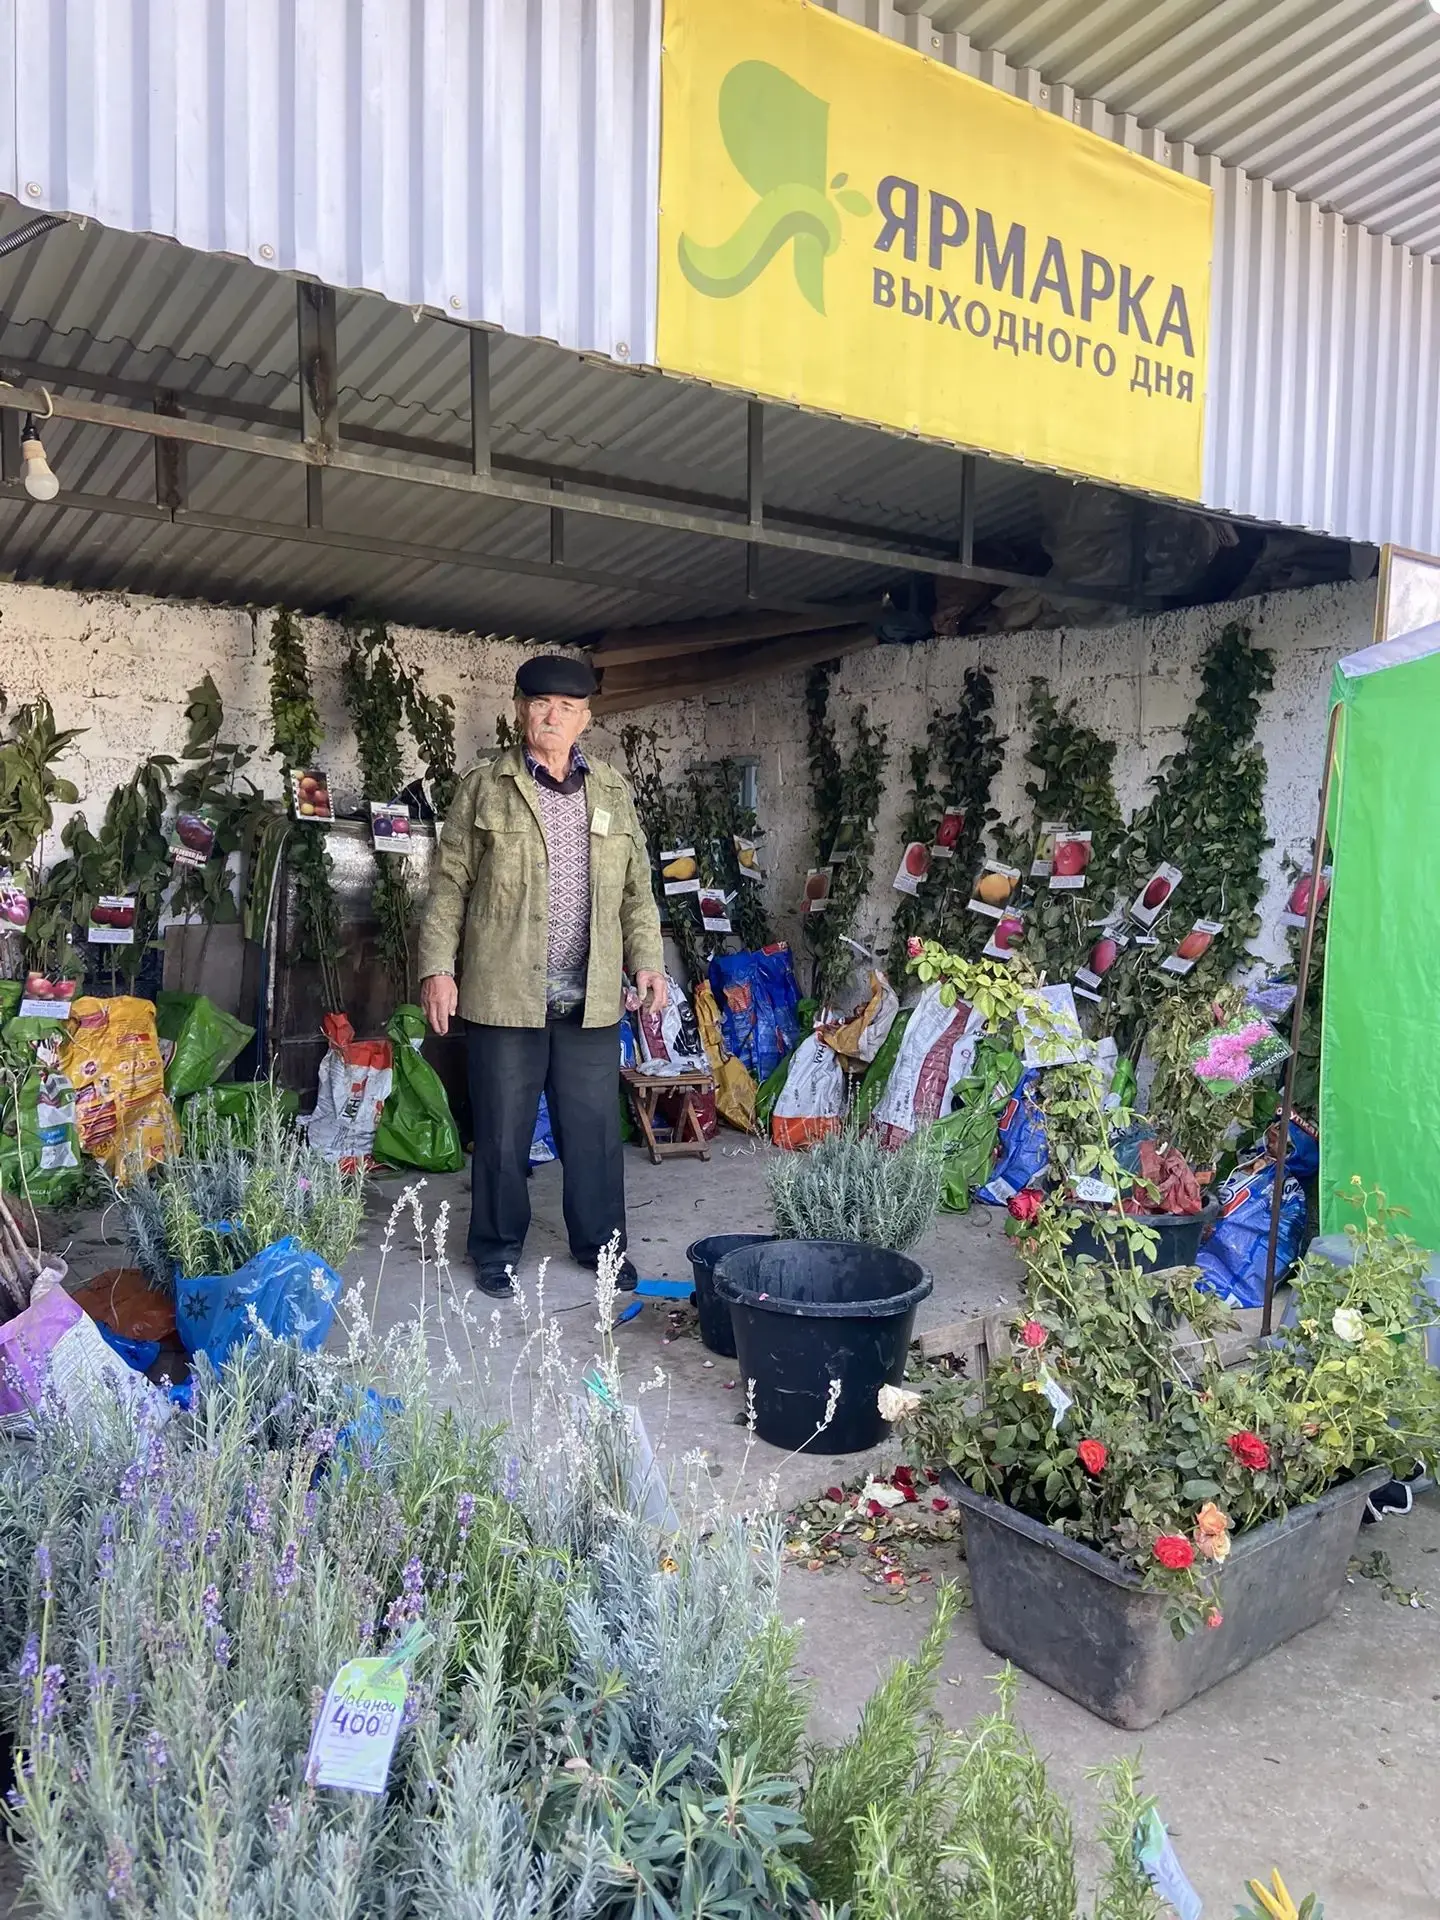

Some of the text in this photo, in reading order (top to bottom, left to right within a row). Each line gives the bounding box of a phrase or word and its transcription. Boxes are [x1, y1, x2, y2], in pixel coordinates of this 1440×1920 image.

[873, 175, 1195, 358] ЯРМАРКА
[873, 267, 1194, 403] ВЫХОДНОГО ДНЯ
[330, 1703, 380, 1737] 400
